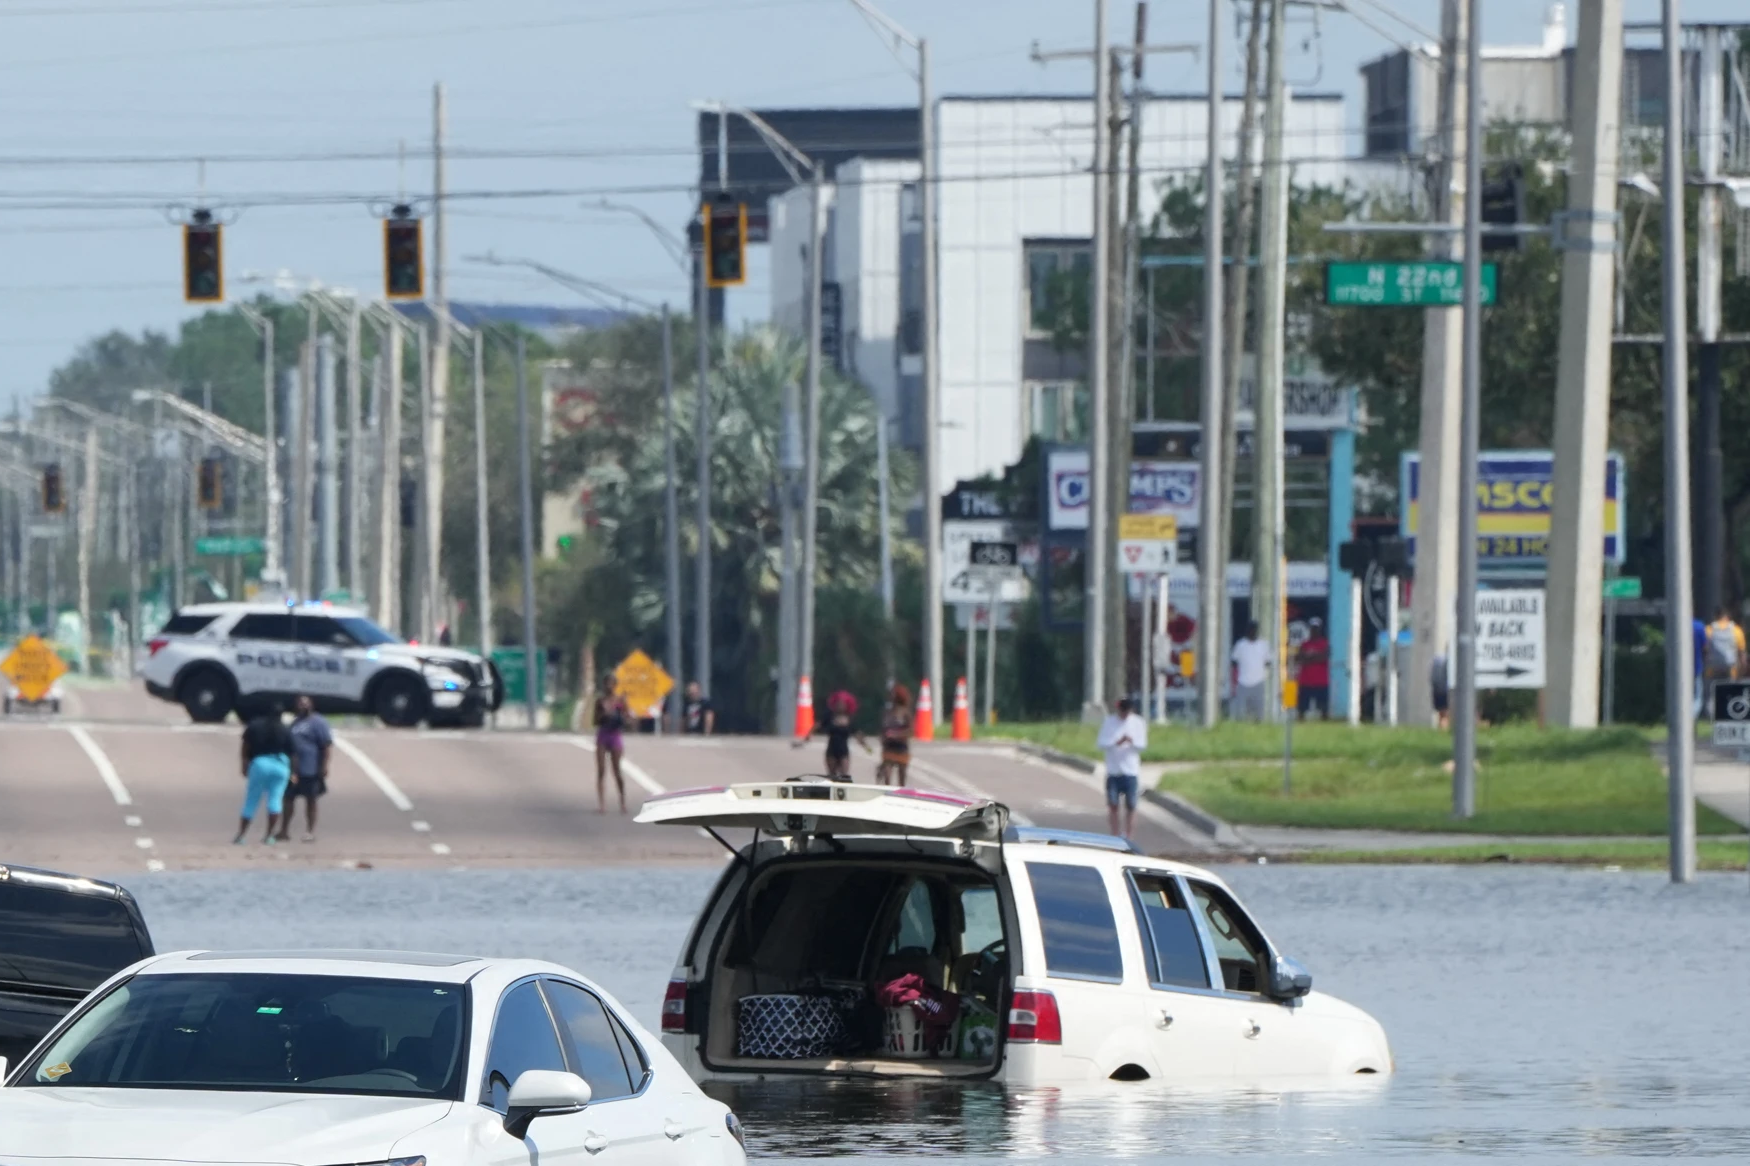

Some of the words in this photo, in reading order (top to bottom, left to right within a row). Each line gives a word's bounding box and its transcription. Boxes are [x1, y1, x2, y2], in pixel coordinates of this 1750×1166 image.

[1367, 266, 1385, 285] N
[1397, 265, 1457, 287] 22nd
[237, 653, 341, 675] POLICE
